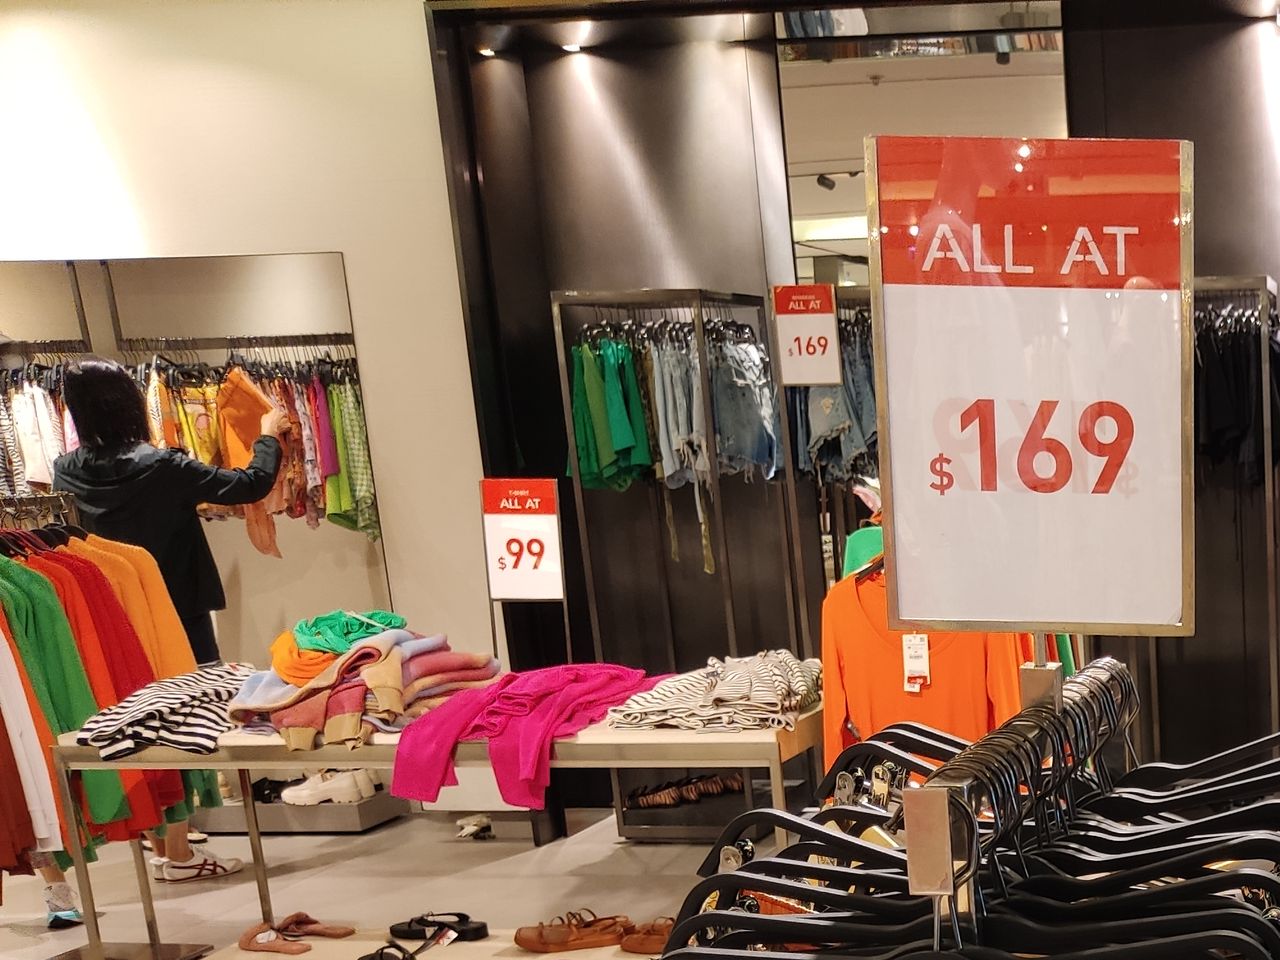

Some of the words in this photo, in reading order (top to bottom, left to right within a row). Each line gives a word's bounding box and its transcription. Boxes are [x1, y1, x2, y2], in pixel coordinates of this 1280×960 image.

[921, 223, 1034, 273] ALL
[1060, 226, 1139, 276] AT
[788, 301, 806, 310] ALL
[808, 299, 822, 310] AT
[788, 335, 829, 357] $169
[929, 398, 1135, 496] $169
[500, 498, 522, 510] ALL
[525, 498, 541, 510] AT
[498, 538, 545, 571] $99
